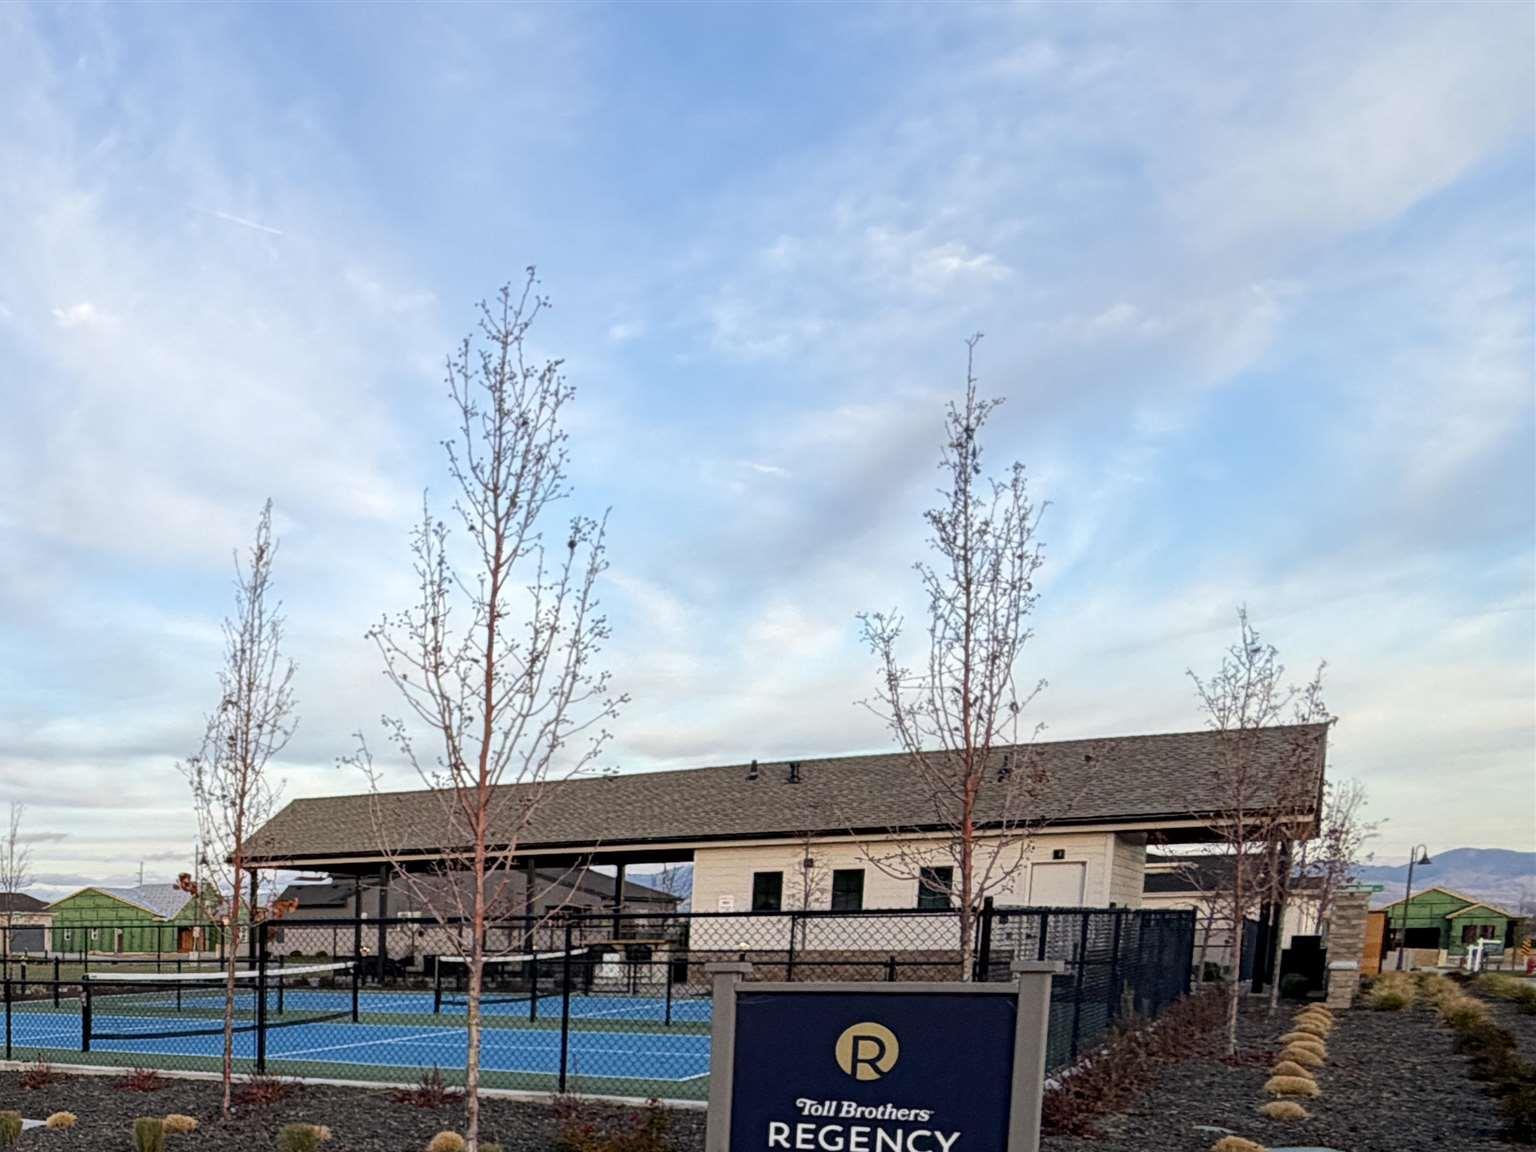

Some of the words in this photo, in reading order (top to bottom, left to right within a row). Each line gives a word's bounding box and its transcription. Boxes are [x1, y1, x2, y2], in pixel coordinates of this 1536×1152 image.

[851, 1035, 887, 1079] R
[795, 1098, 837, 1117] Toll
[839, 1100, 932, 1122] Brothers
